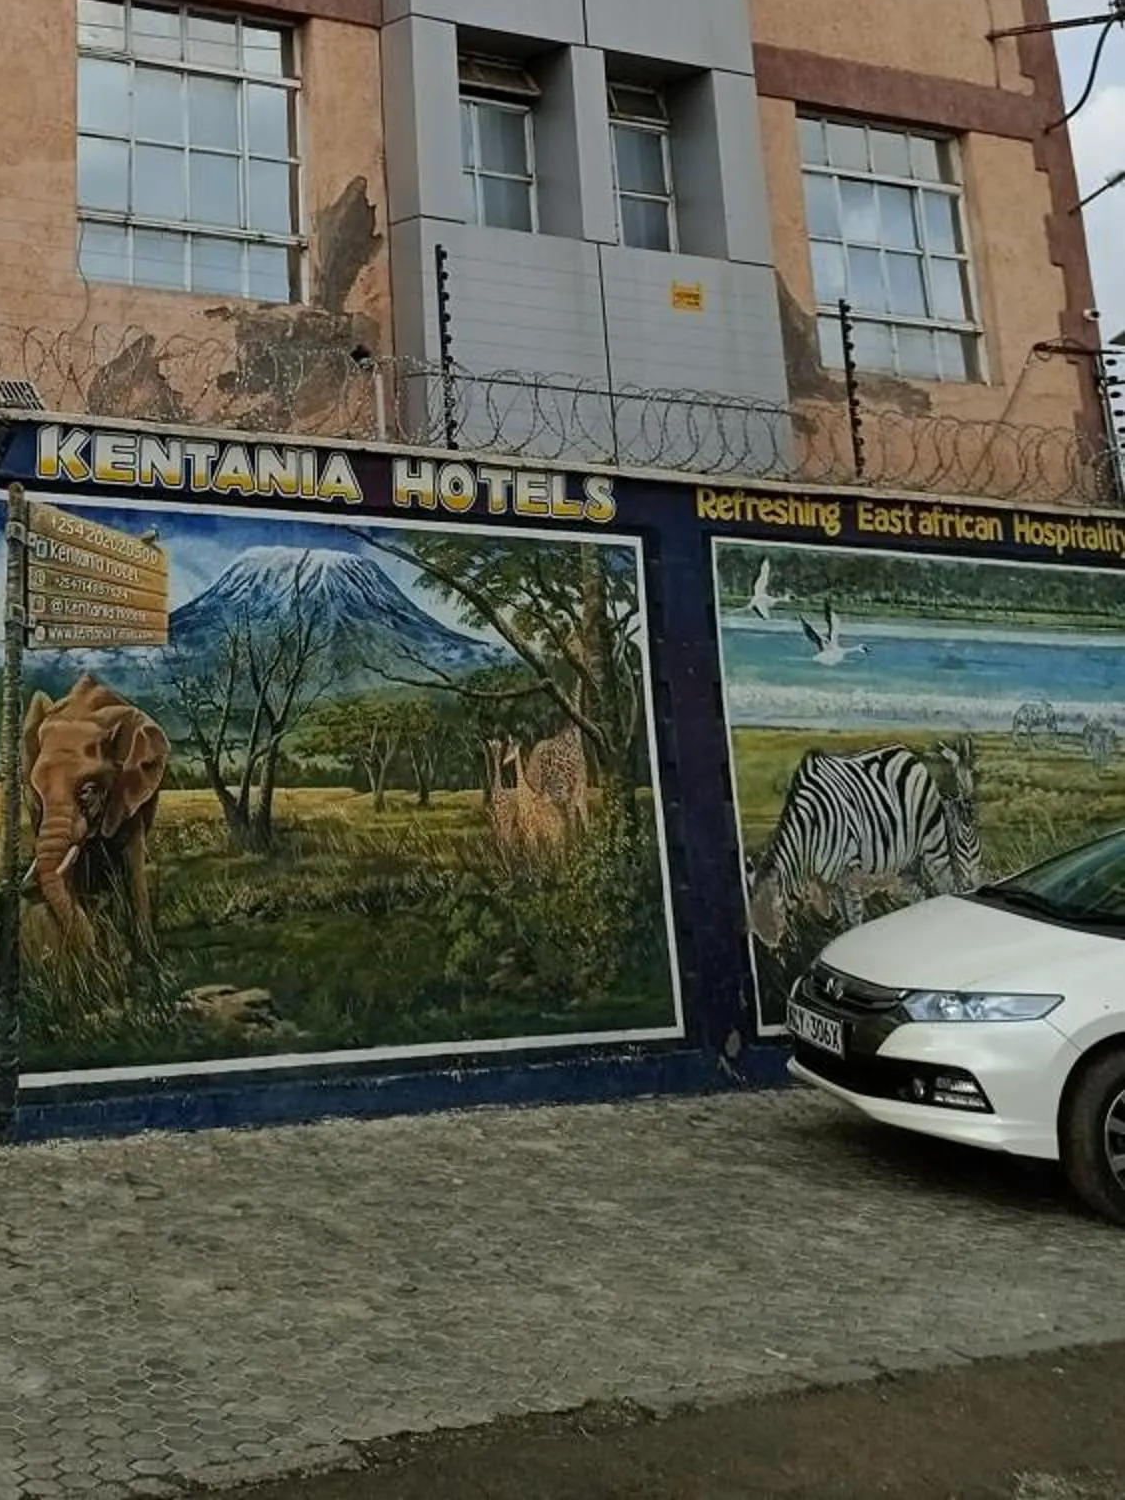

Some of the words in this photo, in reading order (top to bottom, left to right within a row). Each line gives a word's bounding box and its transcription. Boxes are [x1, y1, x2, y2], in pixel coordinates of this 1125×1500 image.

[36, 423, 363, 506] KENTANIA
[393, 457, 617, 523] HOTELS
[696, 487, 842, 536] Refreshing
[857, 501, 914, 535] East
[918, 506, 1004, 541] african
[1013, 513, 1125, 558] Hospitality
